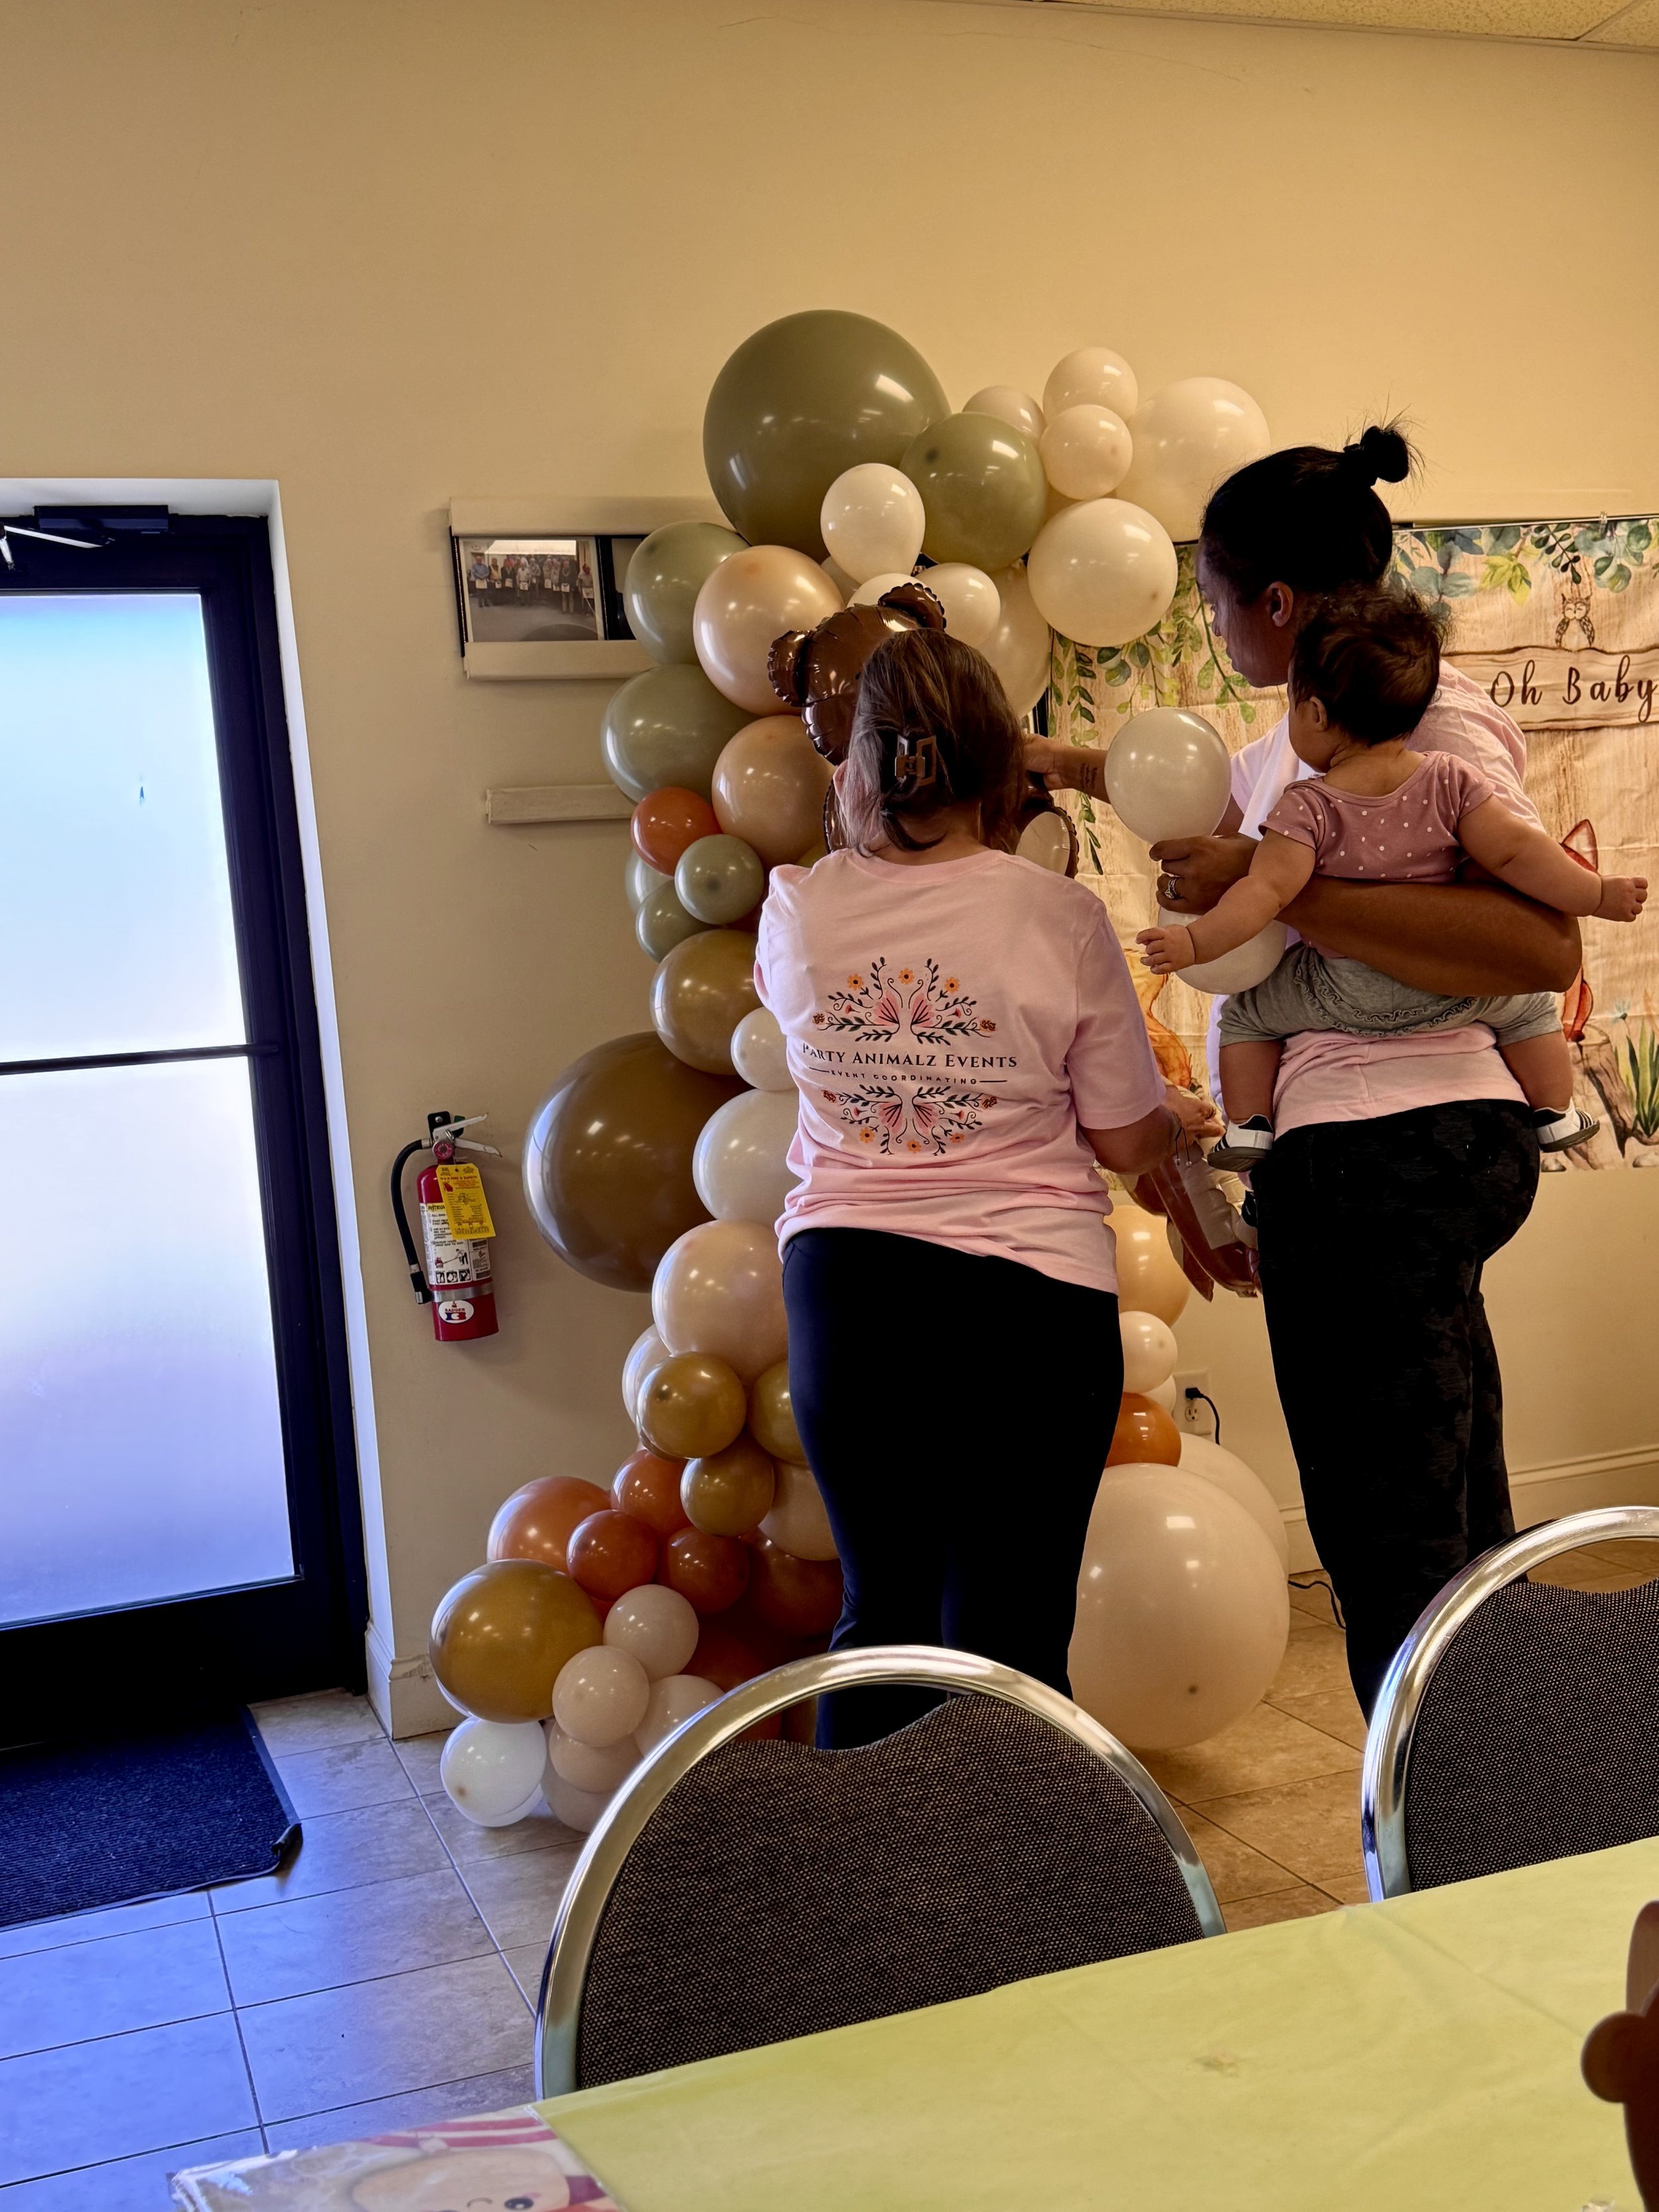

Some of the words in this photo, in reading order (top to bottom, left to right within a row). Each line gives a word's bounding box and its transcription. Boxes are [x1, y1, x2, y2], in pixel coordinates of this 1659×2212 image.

[1490, 660, 1542, 707] Oh
[1562, 655, 1658, 723] Baby
[803, 1043, 845, 1063] PARTY
[852, 1051, 937, 1067] ANIMALZ
[945, 1054, 1017, 1068] EVENTS
[831, 1070, 865, 1078] EVENT
[873, 1074, 977, 1084] COORDINATING
